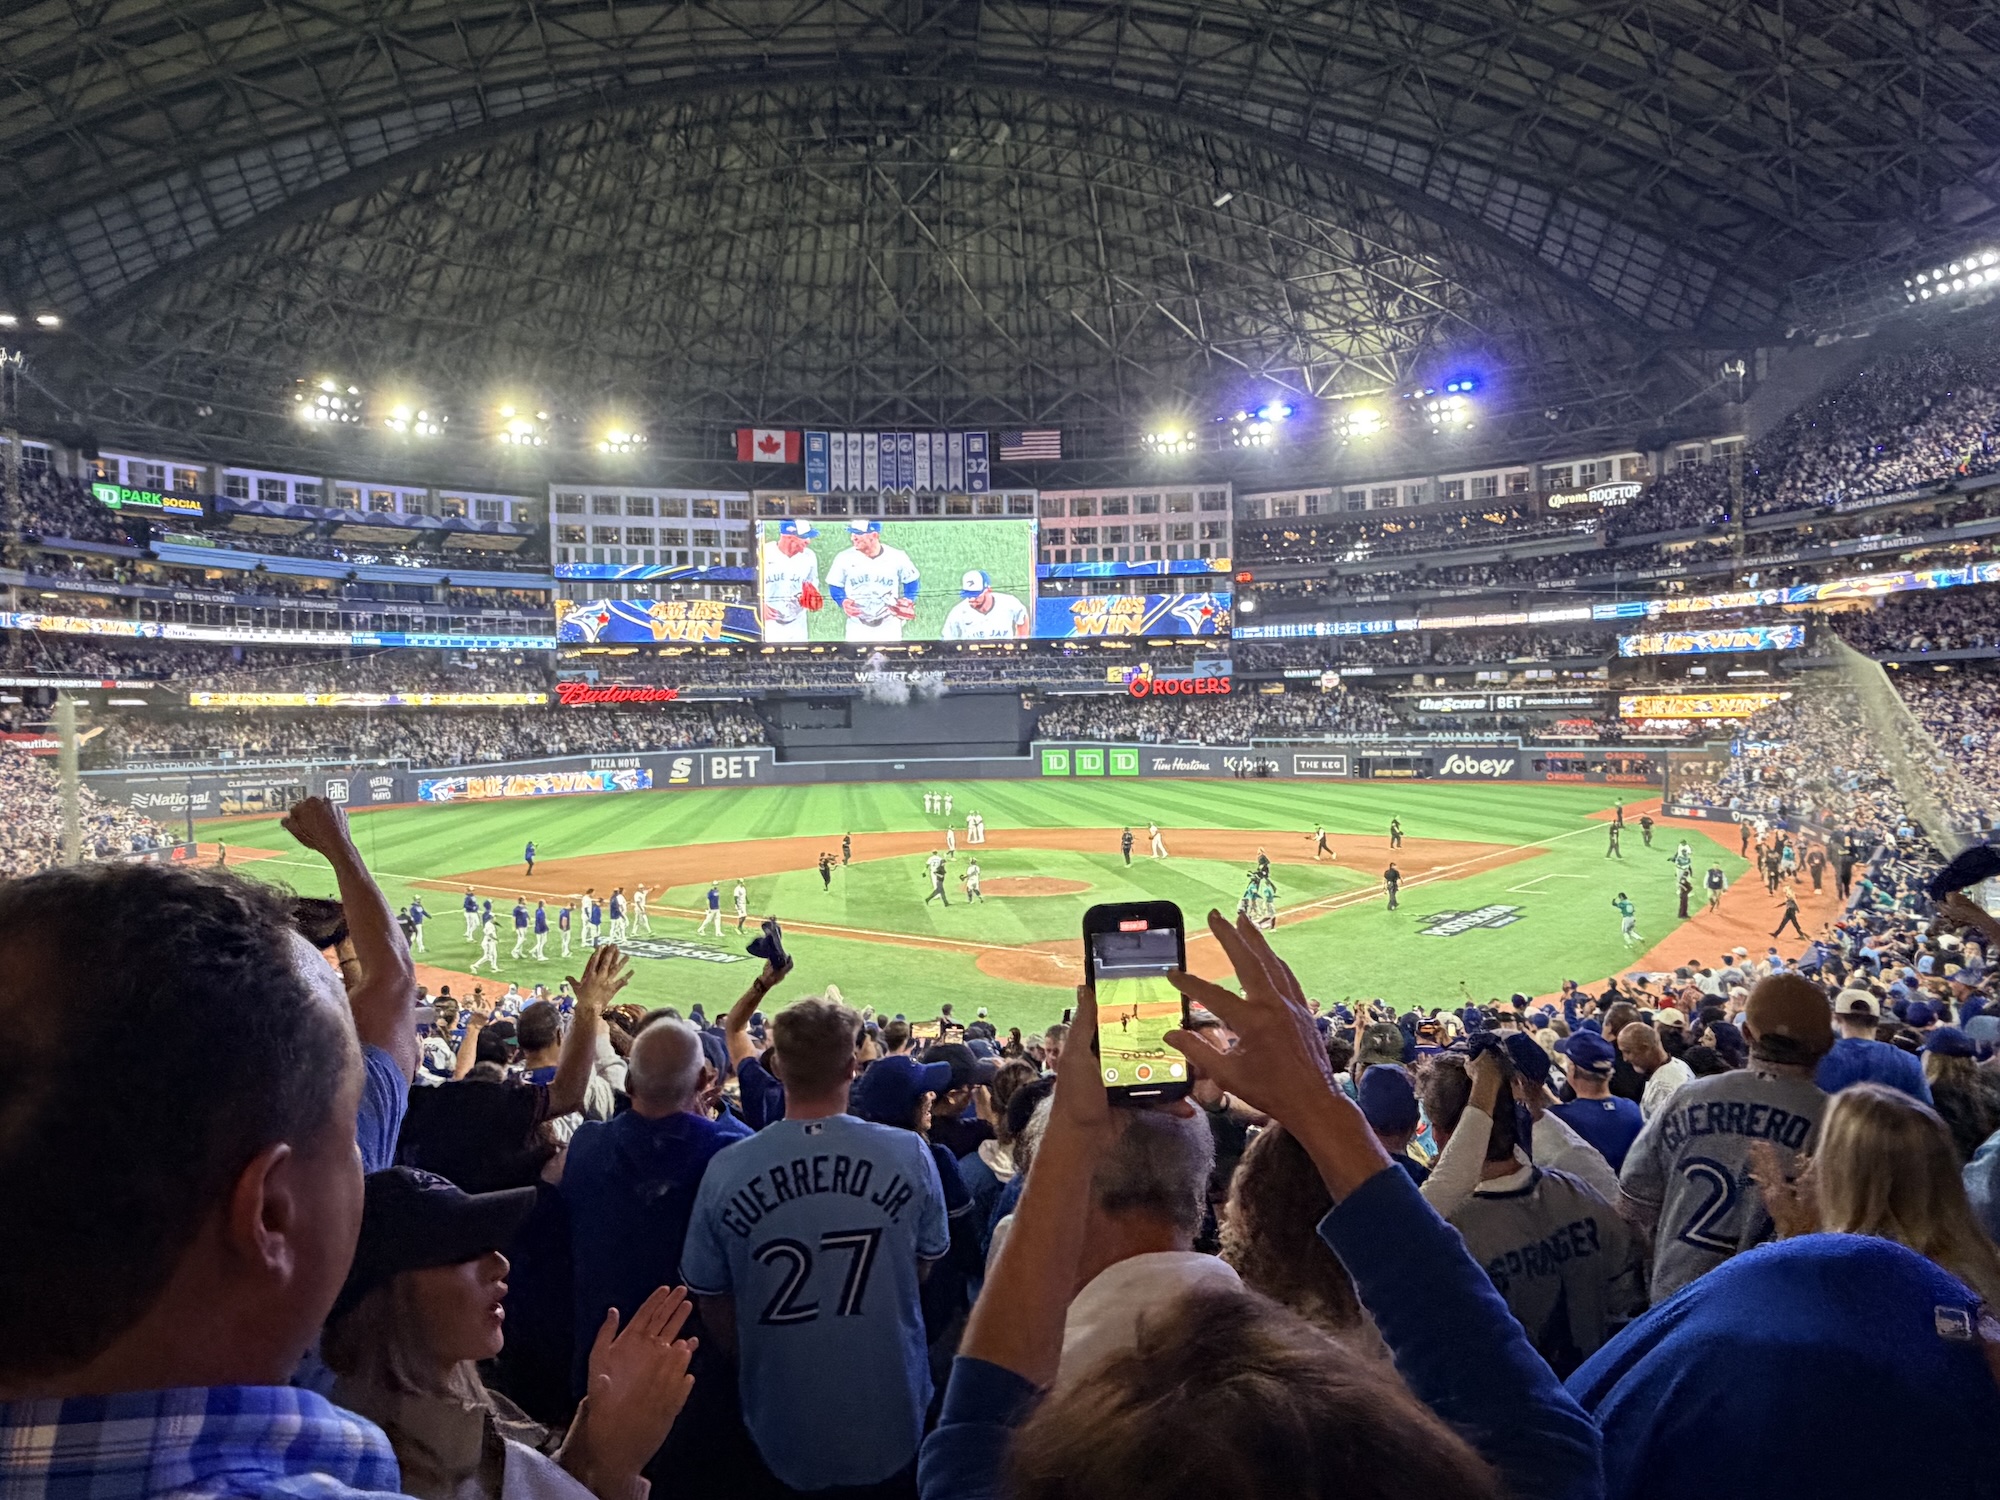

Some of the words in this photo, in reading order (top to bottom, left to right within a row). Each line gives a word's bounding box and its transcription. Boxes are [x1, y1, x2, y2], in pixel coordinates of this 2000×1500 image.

[966, 458, 988, 474] 32
[97, 487, 118, 504] TD
[121, 489, 162, 505] PARK
[162, 497, 202, 510] SOCIAL
[1548, 493, 1588, 508] Corona
[1589, 484, 1642, 503] ROOFTOP
[1603, 498, 1627, 507] PATIO
[1875, 491, 1920, 505] ROBINSON
[1881, 536, 1925, 549] BAUTISTA
[1759, 553, 1799, 565] HALLADAY
[1637, 570, 1655, 579] PAUL
[55, 581, 84, 592] CARLOS
[400, 605, 424, 613] CARTER
[688, 602, 726, 621] JAYS
[651, 620, 723, 641] WIN
[1074, 614, 1143, 635] WIN
[1709, 632, 1761, 648] WIN
[854, 671, 908, 682] WESTJET
[555, 683, 678, 705] Budweiser
[1152, 676, 1232, 696] ROGERS
[1419, 698, 1487, 712] theScore
[1496, 696, 1523, 709] BET
[590, 758, 617, 769] PIZZA
[618, 757, 641, 769] NOVA
[670, 757, 693, 778] S
[711, 756, 761, 779] BET
[1045, 753, 1067, 770] TD
[1079, 753, 1101, 770] TD
[1113, 753, 1136, 770] TD
[1152, 757, 1171, 770] Tim
[1172, 756, 1211, 770] Hortons
[1223, 756, 1280, 772] Kuba
[1300, 760, 1319, 769] THE
[1322, 760, 1341, 769] KEG
[1440, 754, 1515, 777] Sobeys
[369, 776, 394, 789] HEINZ
[547, 772, 604, 793] WIN
[372, 791, 392, 801] MAYO
[1661, 1102, 1812, 1152] GUERRERO
[722, 1154, 873, 1239] GUERRERO
[871, 1173, 914, 1225] JR.
[752, 1227, 883, 1326] 27
